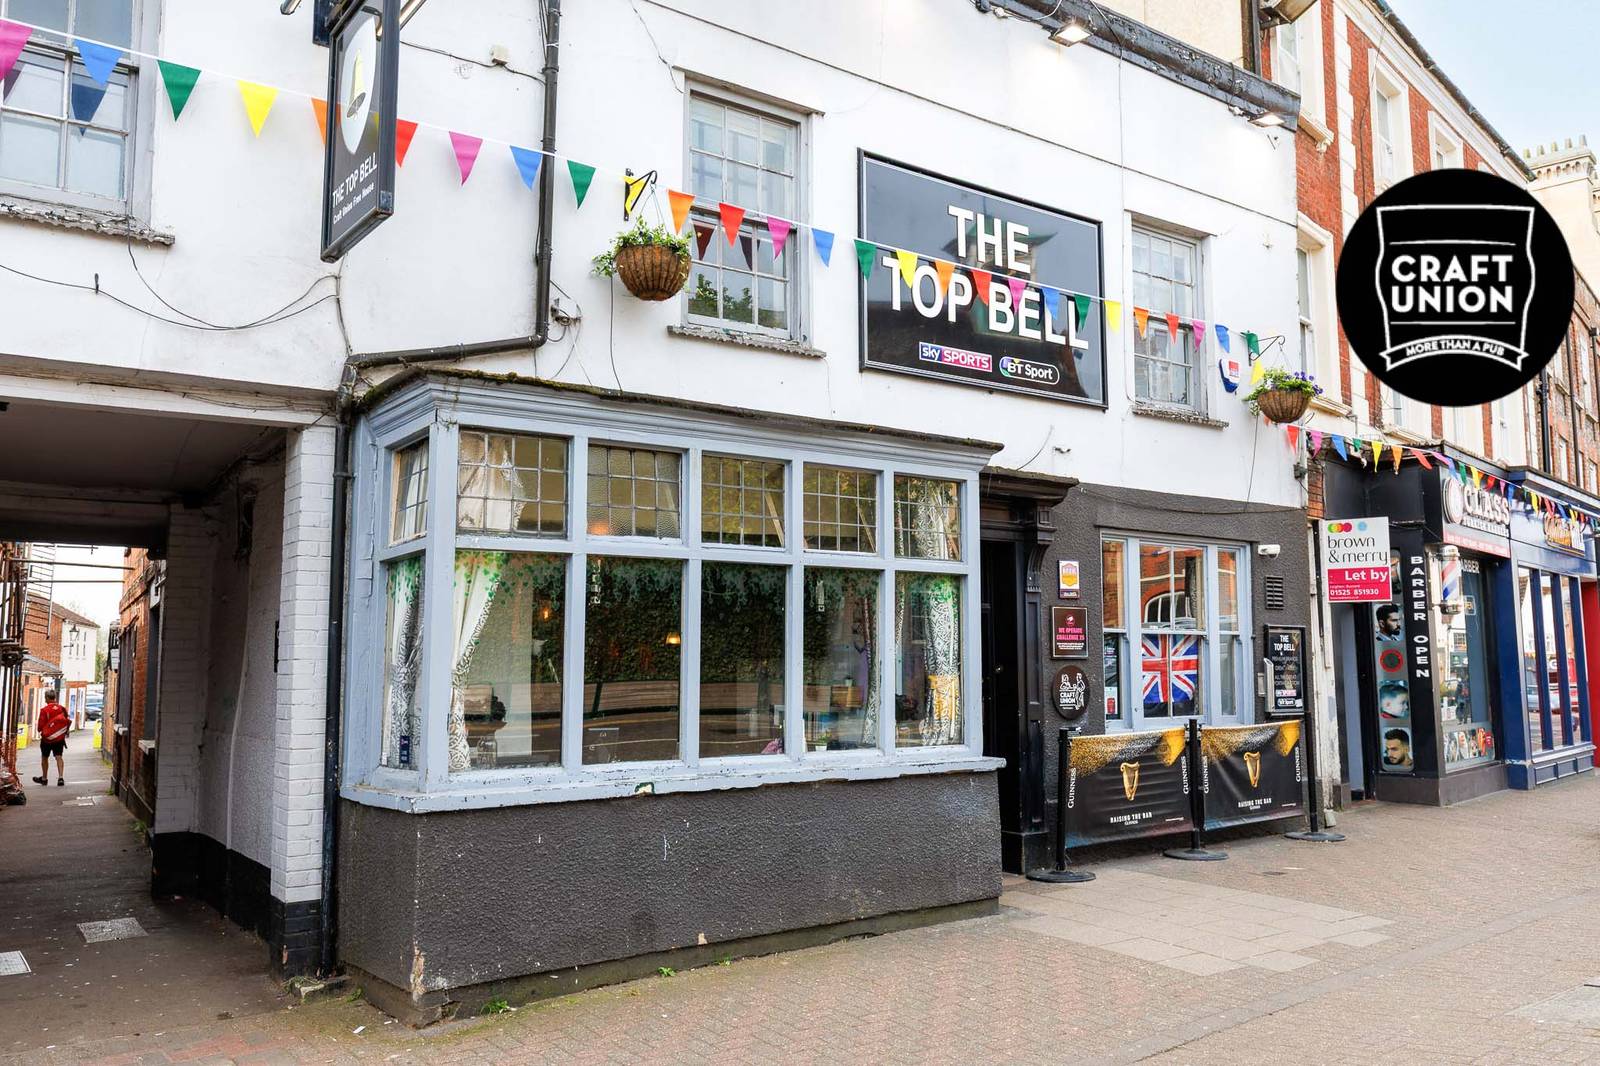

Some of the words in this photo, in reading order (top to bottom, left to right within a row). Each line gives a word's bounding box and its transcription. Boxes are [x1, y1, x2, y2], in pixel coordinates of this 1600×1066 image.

[332, 182, 344, 208] THE
[345, 169, 358, 195] TOP
[359, 152, 377, 183] BELL
[947, 204, 1031, 274] THE
[881, 256, 973, 323] TOP
[987, 280, 1089, 350] BELL
[922, 346, 941, 360] sky
[943, 350, 990, 369] SPORTS
[1007, 362, 1024, 374] BT
[1024, 365, 1053, 380] Sport
[1327, 535, 1375, 548] brown
[1328, 549, 1339, 563] &
[1342, 551, 1388, 565] merry
[1344, 570, 1366, 581] Let
[1370, 569, 1388, 582] by
[1410, 556, 1426, 621] BARBER
[1273, 643, 1283, 651] TOP
[1283, 643, 1295, 651] BELL
[1413, 635, 1429, 678] OPEN
[1181, 756, 1189, 794] GUINNESS
[1067, 767, 1077, 808] GUINNESS
[1238, 800, 1254, 808] RAISING
[1110, 815, 1131, 823] RAISING
